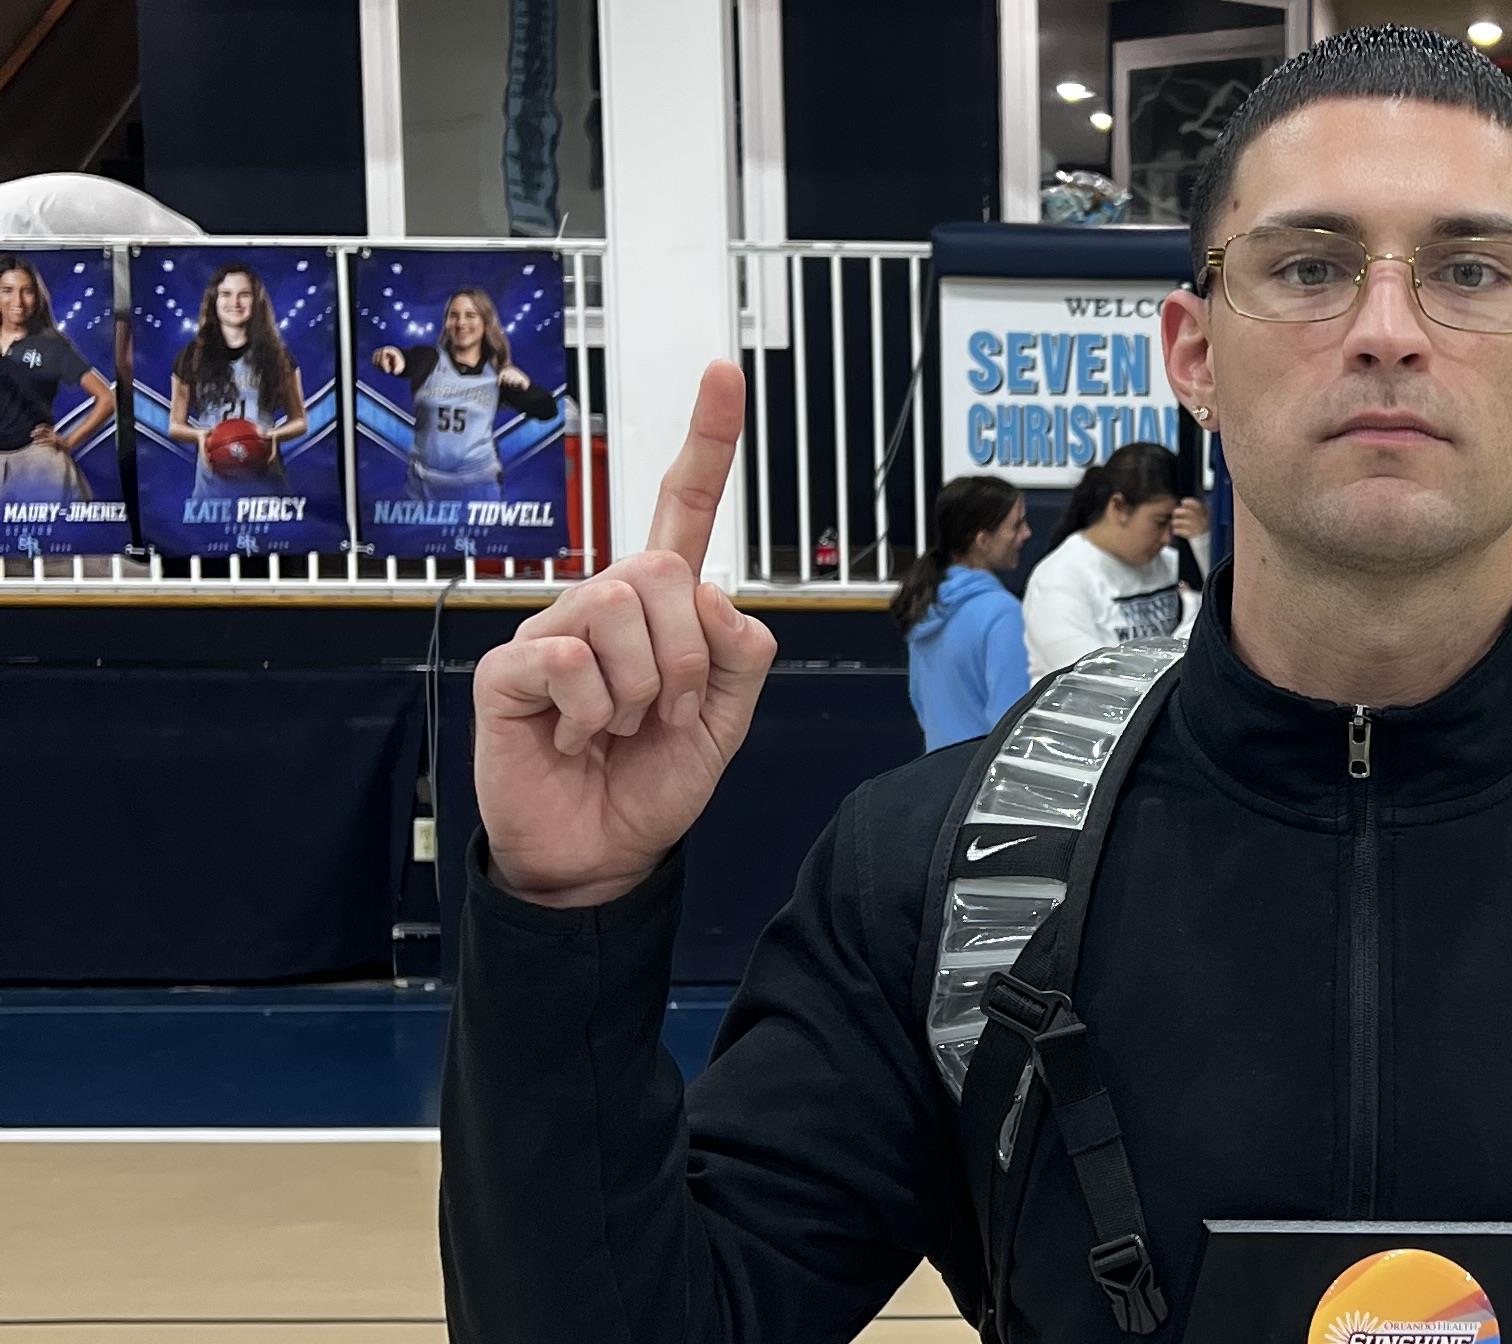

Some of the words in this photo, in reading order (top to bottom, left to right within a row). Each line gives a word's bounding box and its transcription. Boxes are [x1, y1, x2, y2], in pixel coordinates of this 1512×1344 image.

[966, 329, 1151, 396] SEVEN
[436, 407, 467, 433] 55
[182, 498, 233, 524] KATE
[236, 496, 307, 523] PIERCY
[373, 500, 462, 525] NATALEE
[467, 501, 554, 527] TIDWELL
[1384, 1321, 1436, 1331] ORLANDO
